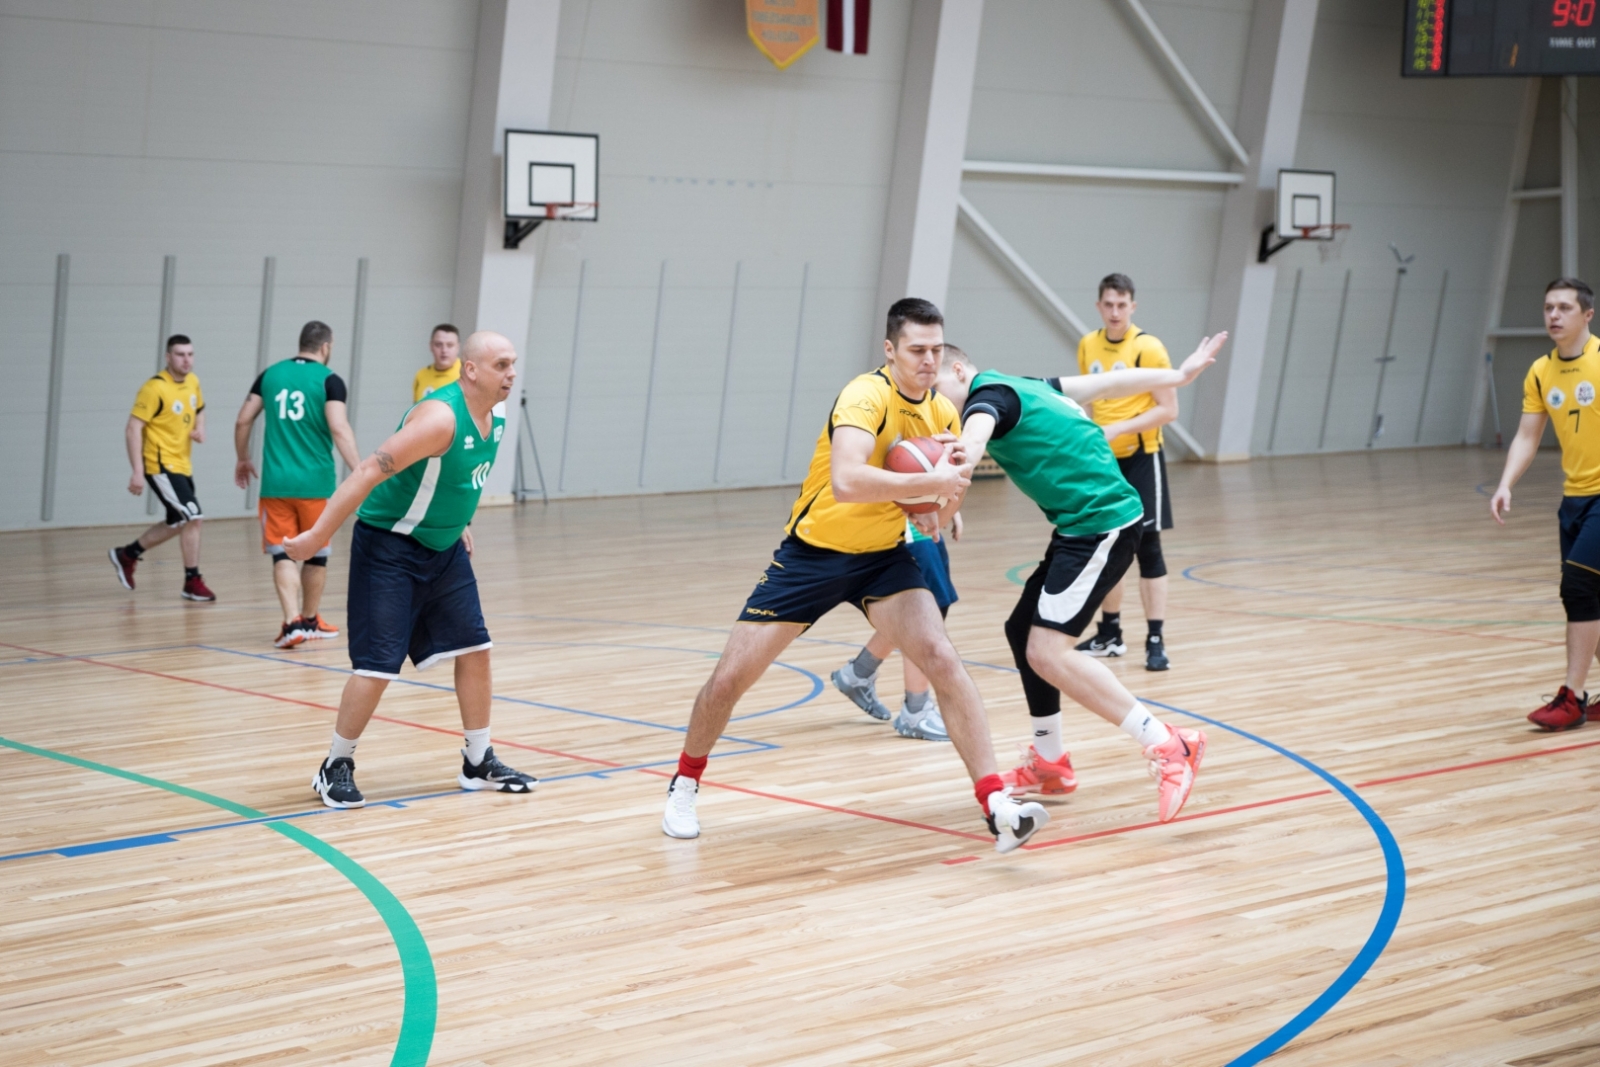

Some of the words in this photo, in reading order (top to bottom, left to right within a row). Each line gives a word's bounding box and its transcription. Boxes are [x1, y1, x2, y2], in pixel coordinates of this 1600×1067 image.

[1549, 36, 1575, 49] TIME
[1576, 36, 1597, 49] OUT
[274, 387, 306, 422] 13
[1568, 408, 1581, 434] 7
[471, 461, 491, 490] 10
[745, 607, 778, 617] ROYAL
